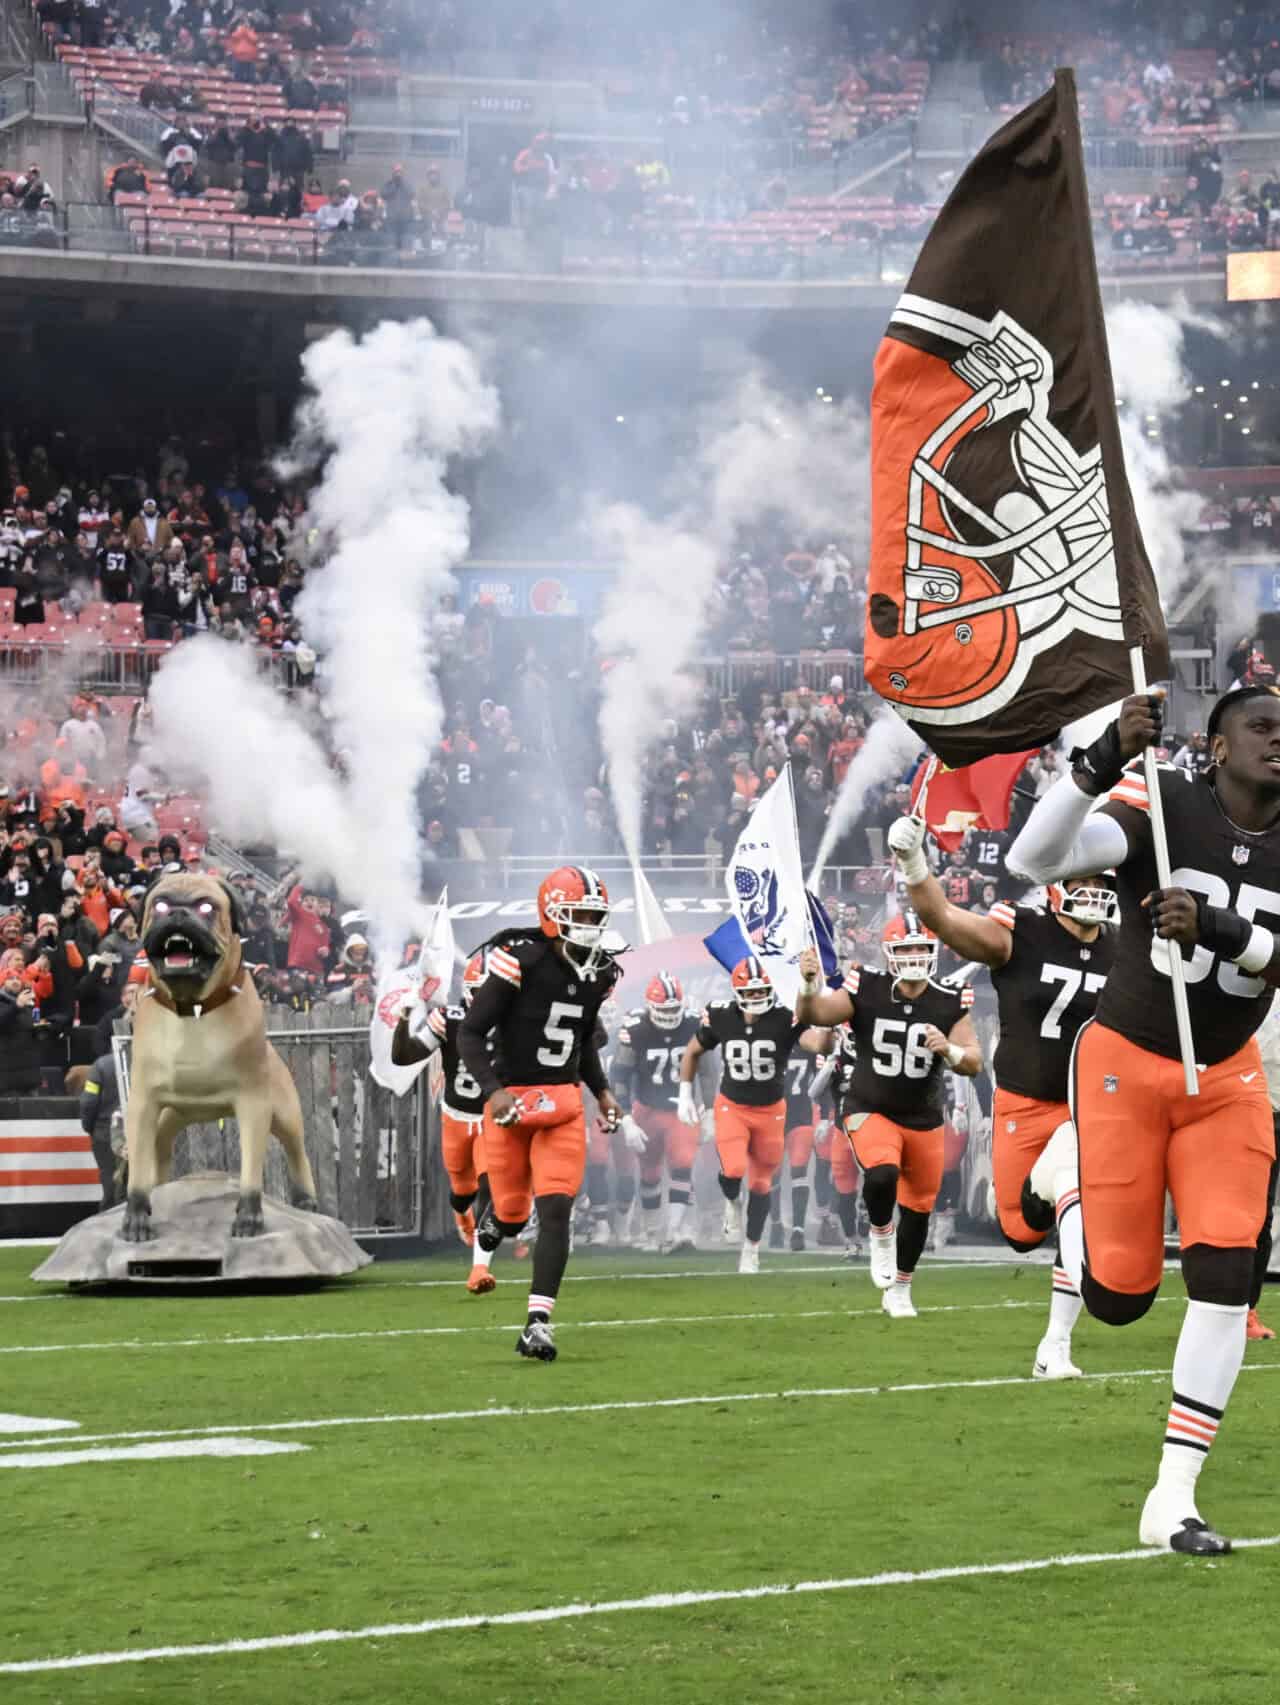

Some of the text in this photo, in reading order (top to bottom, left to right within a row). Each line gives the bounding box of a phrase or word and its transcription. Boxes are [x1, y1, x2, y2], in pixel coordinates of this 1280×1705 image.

[106, 553, 126, 571] 57
[231, 576, 247, 592] 16
[457, 763, 471, 784] 2
[977, 841, 999, 865] 12
[536, 1001, 584, 1067] 5
[872, 1017, 934, 1079] 56
[725, 1039, 776, 1081] 86
[787, 1058, 814, 1096] 7
